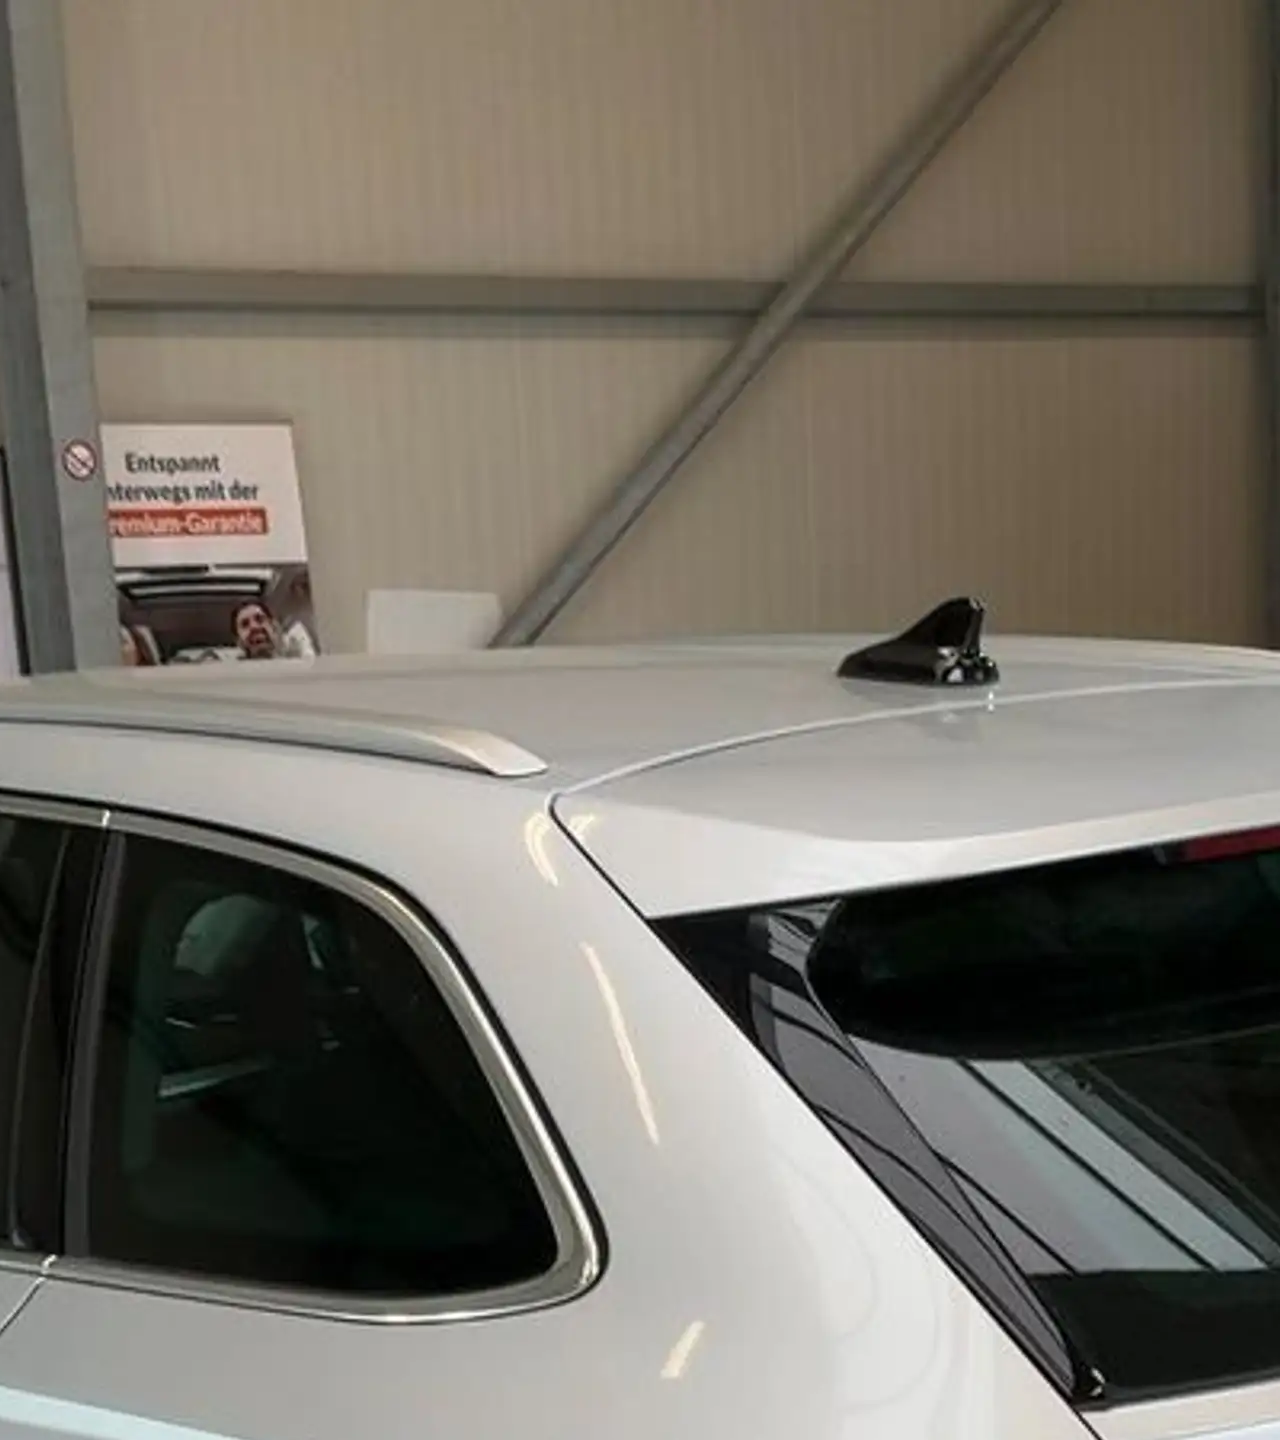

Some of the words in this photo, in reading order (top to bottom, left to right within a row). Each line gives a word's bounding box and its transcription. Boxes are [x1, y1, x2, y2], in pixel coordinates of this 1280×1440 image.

[124, 453, 221, 475] Entspannt
[107, 482, 191, 503] nterwegs
[194, 479, 224, 500] mit
[227, 478, 259, 500] der
[108, 510, 264, 536] remium-Garantie
